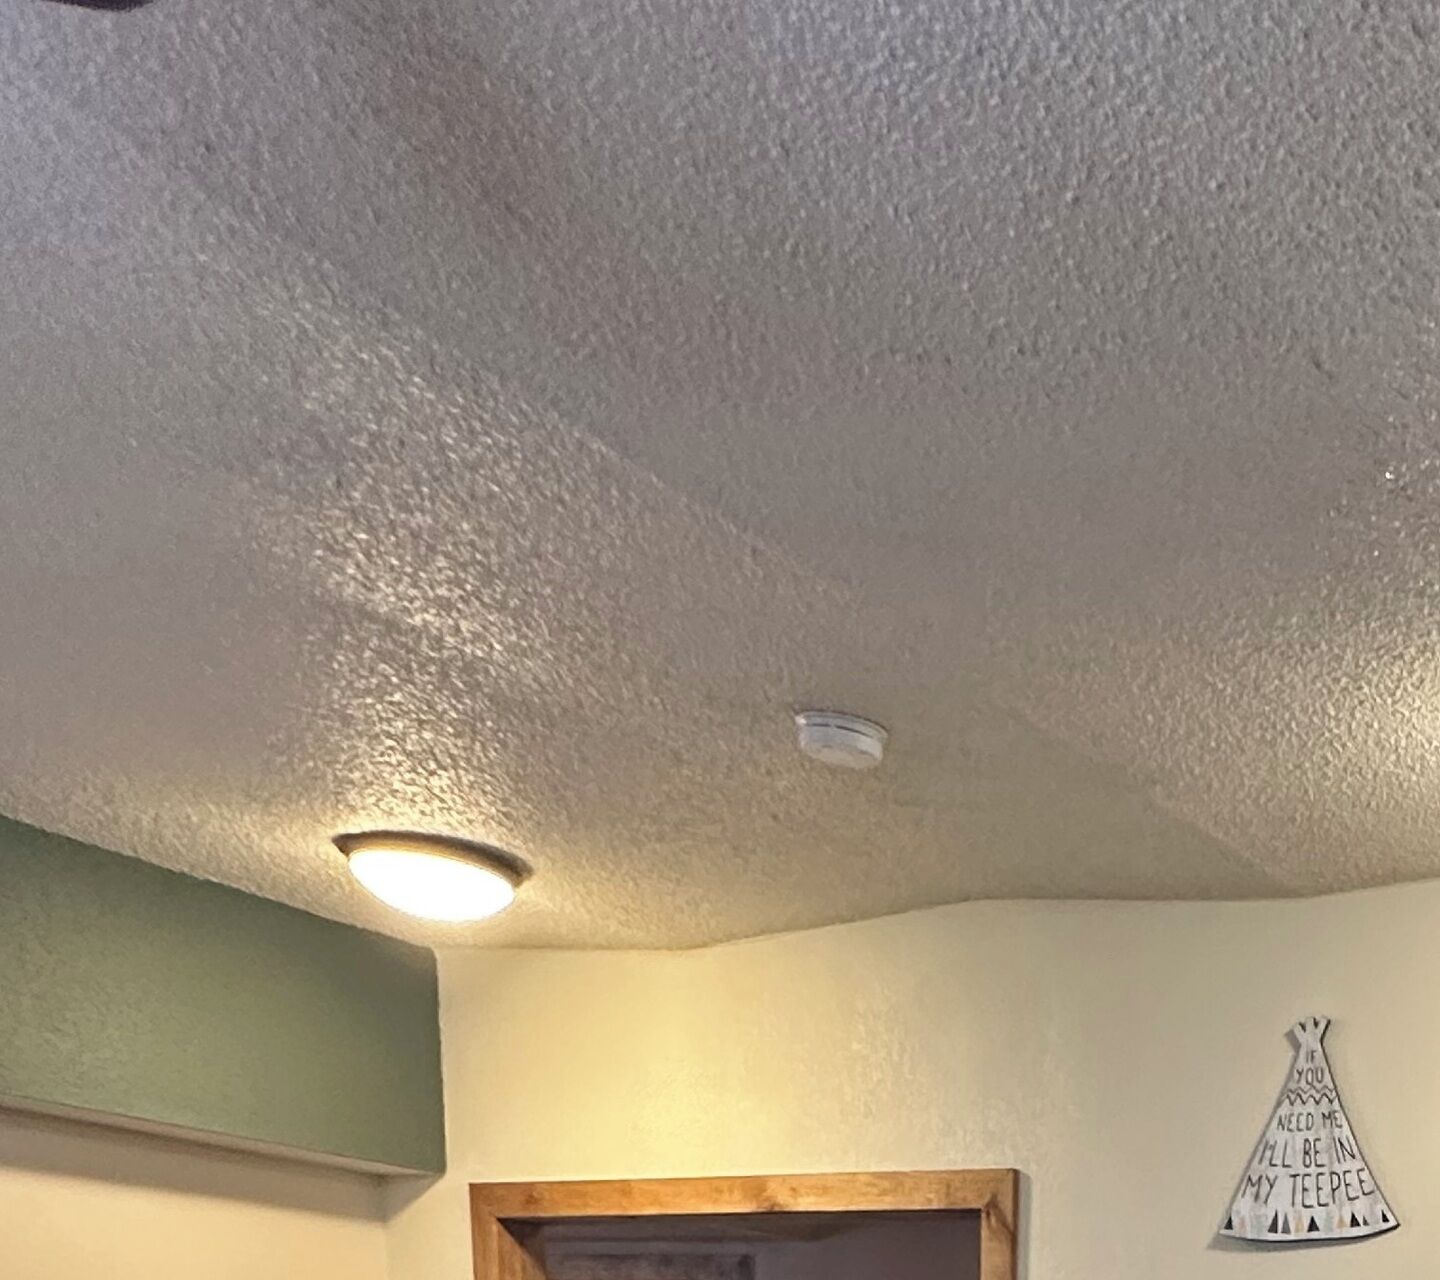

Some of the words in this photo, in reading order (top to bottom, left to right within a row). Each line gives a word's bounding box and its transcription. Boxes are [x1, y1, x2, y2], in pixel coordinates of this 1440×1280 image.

[1305, 1050, 1317, 1063] IF
[1295, 1067, 1324, 1085] YOU
[1276, 1111, 1314, 1132] NEED
[1321, 1111, 1343, 1130] ME
[1258, 1139, 1292, 1169] I'LL
[1303, 1138, 1326, 1168] BE
[1335, 1136, 1357, 1164] IN
[1241, 1174, 1278, 1205] MY
[1289, 1167, 1375, 1209] TEEPEE
